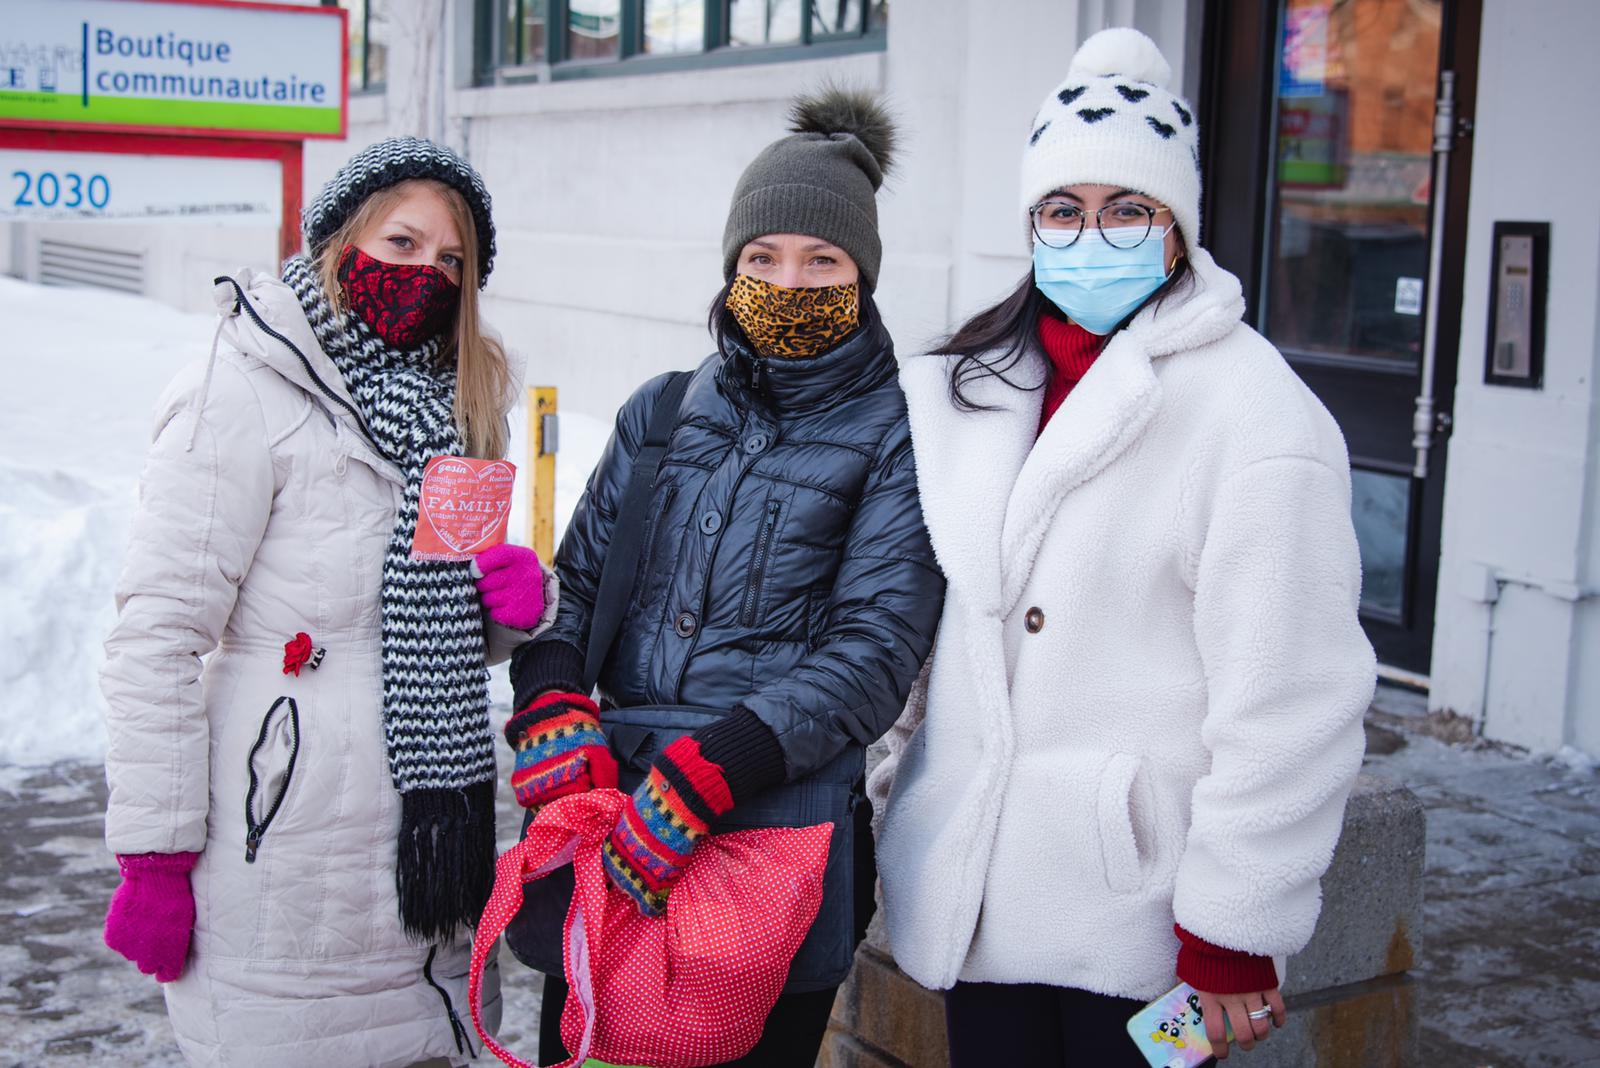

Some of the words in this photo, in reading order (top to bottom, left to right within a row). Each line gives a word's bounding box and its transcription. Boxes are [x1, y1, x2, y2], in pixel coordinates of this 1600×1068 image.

[96, 28, 231, 67] Boutique
[96, 71, 326, 103] communautaire
[12, 171, 110, 209] 2030
[427, 496, 507, 513] FAMILY
